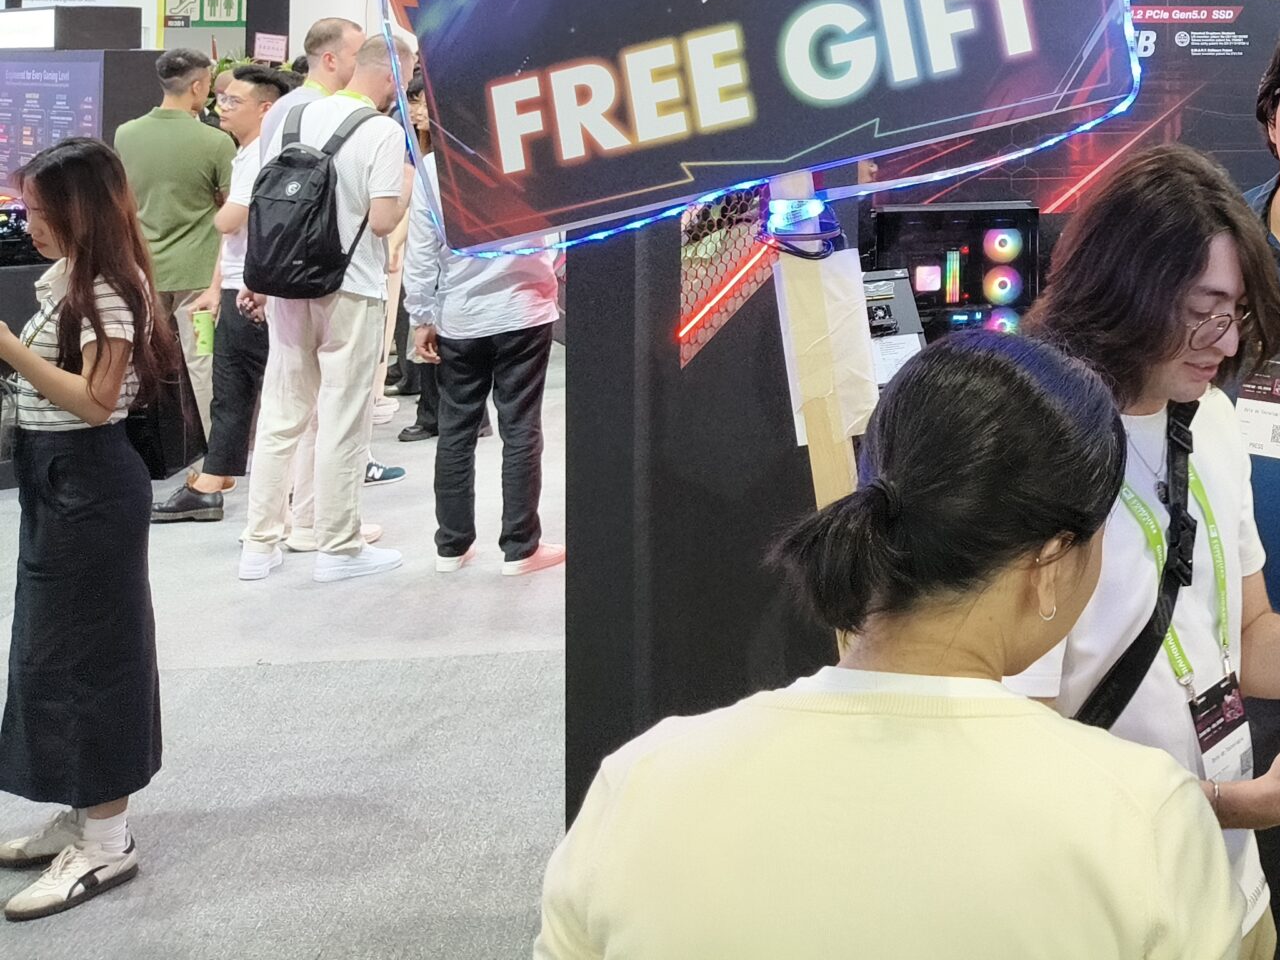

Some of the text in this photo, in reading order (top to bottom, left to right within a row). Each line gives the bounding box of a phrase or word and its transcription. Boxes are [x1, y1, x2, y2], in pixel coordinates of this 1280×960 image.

[1145, 10, 1170, 19] PCIe
[1171, 9, 1208, 20] Gen5.0
[1211, 10, 1234, 19] SSD
[490, 28, 752, 175] FREE
